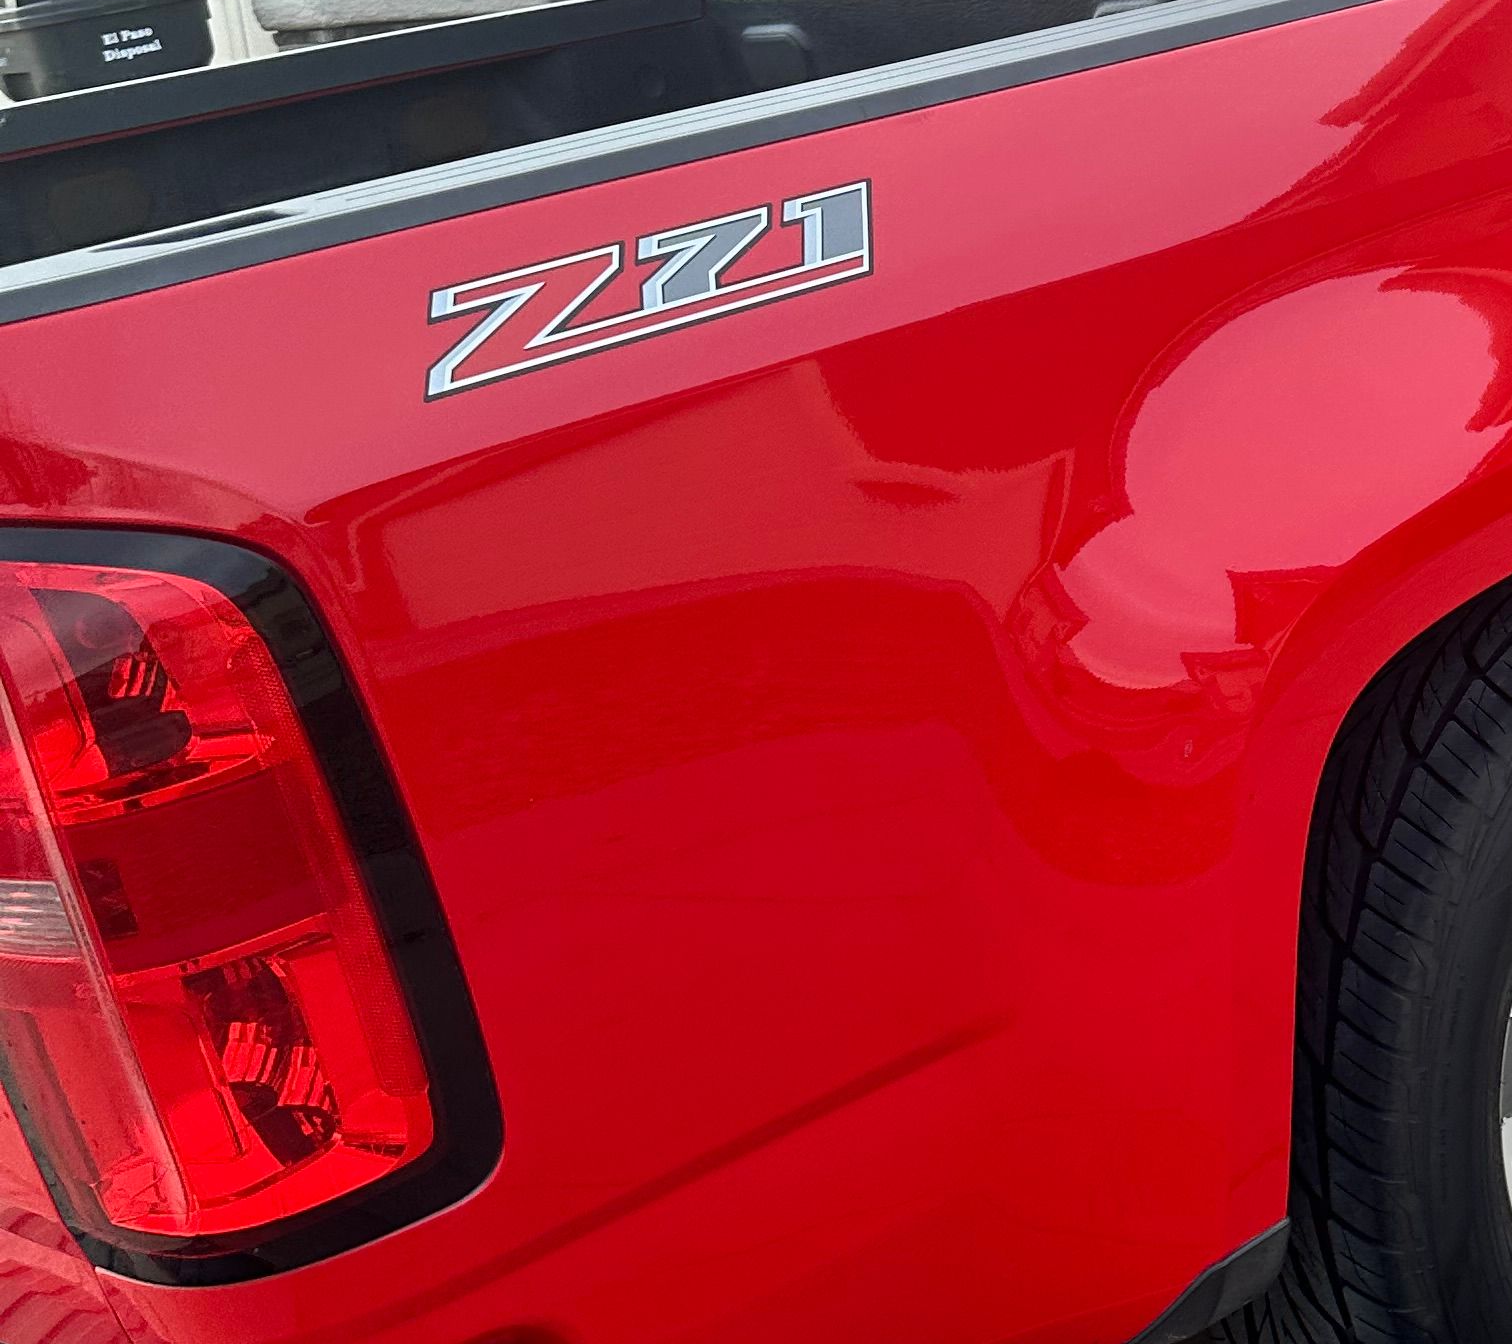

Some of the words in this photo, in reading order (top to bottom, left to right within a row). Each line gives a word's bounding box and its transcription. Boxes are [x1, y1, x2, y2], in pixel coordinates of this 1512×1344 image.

[101, 31, 120, 46] El
[119, 27, 154, 42] Paso
[102, 37, 163, 62] Disposal
[423, 178, 874, 403] Z71
